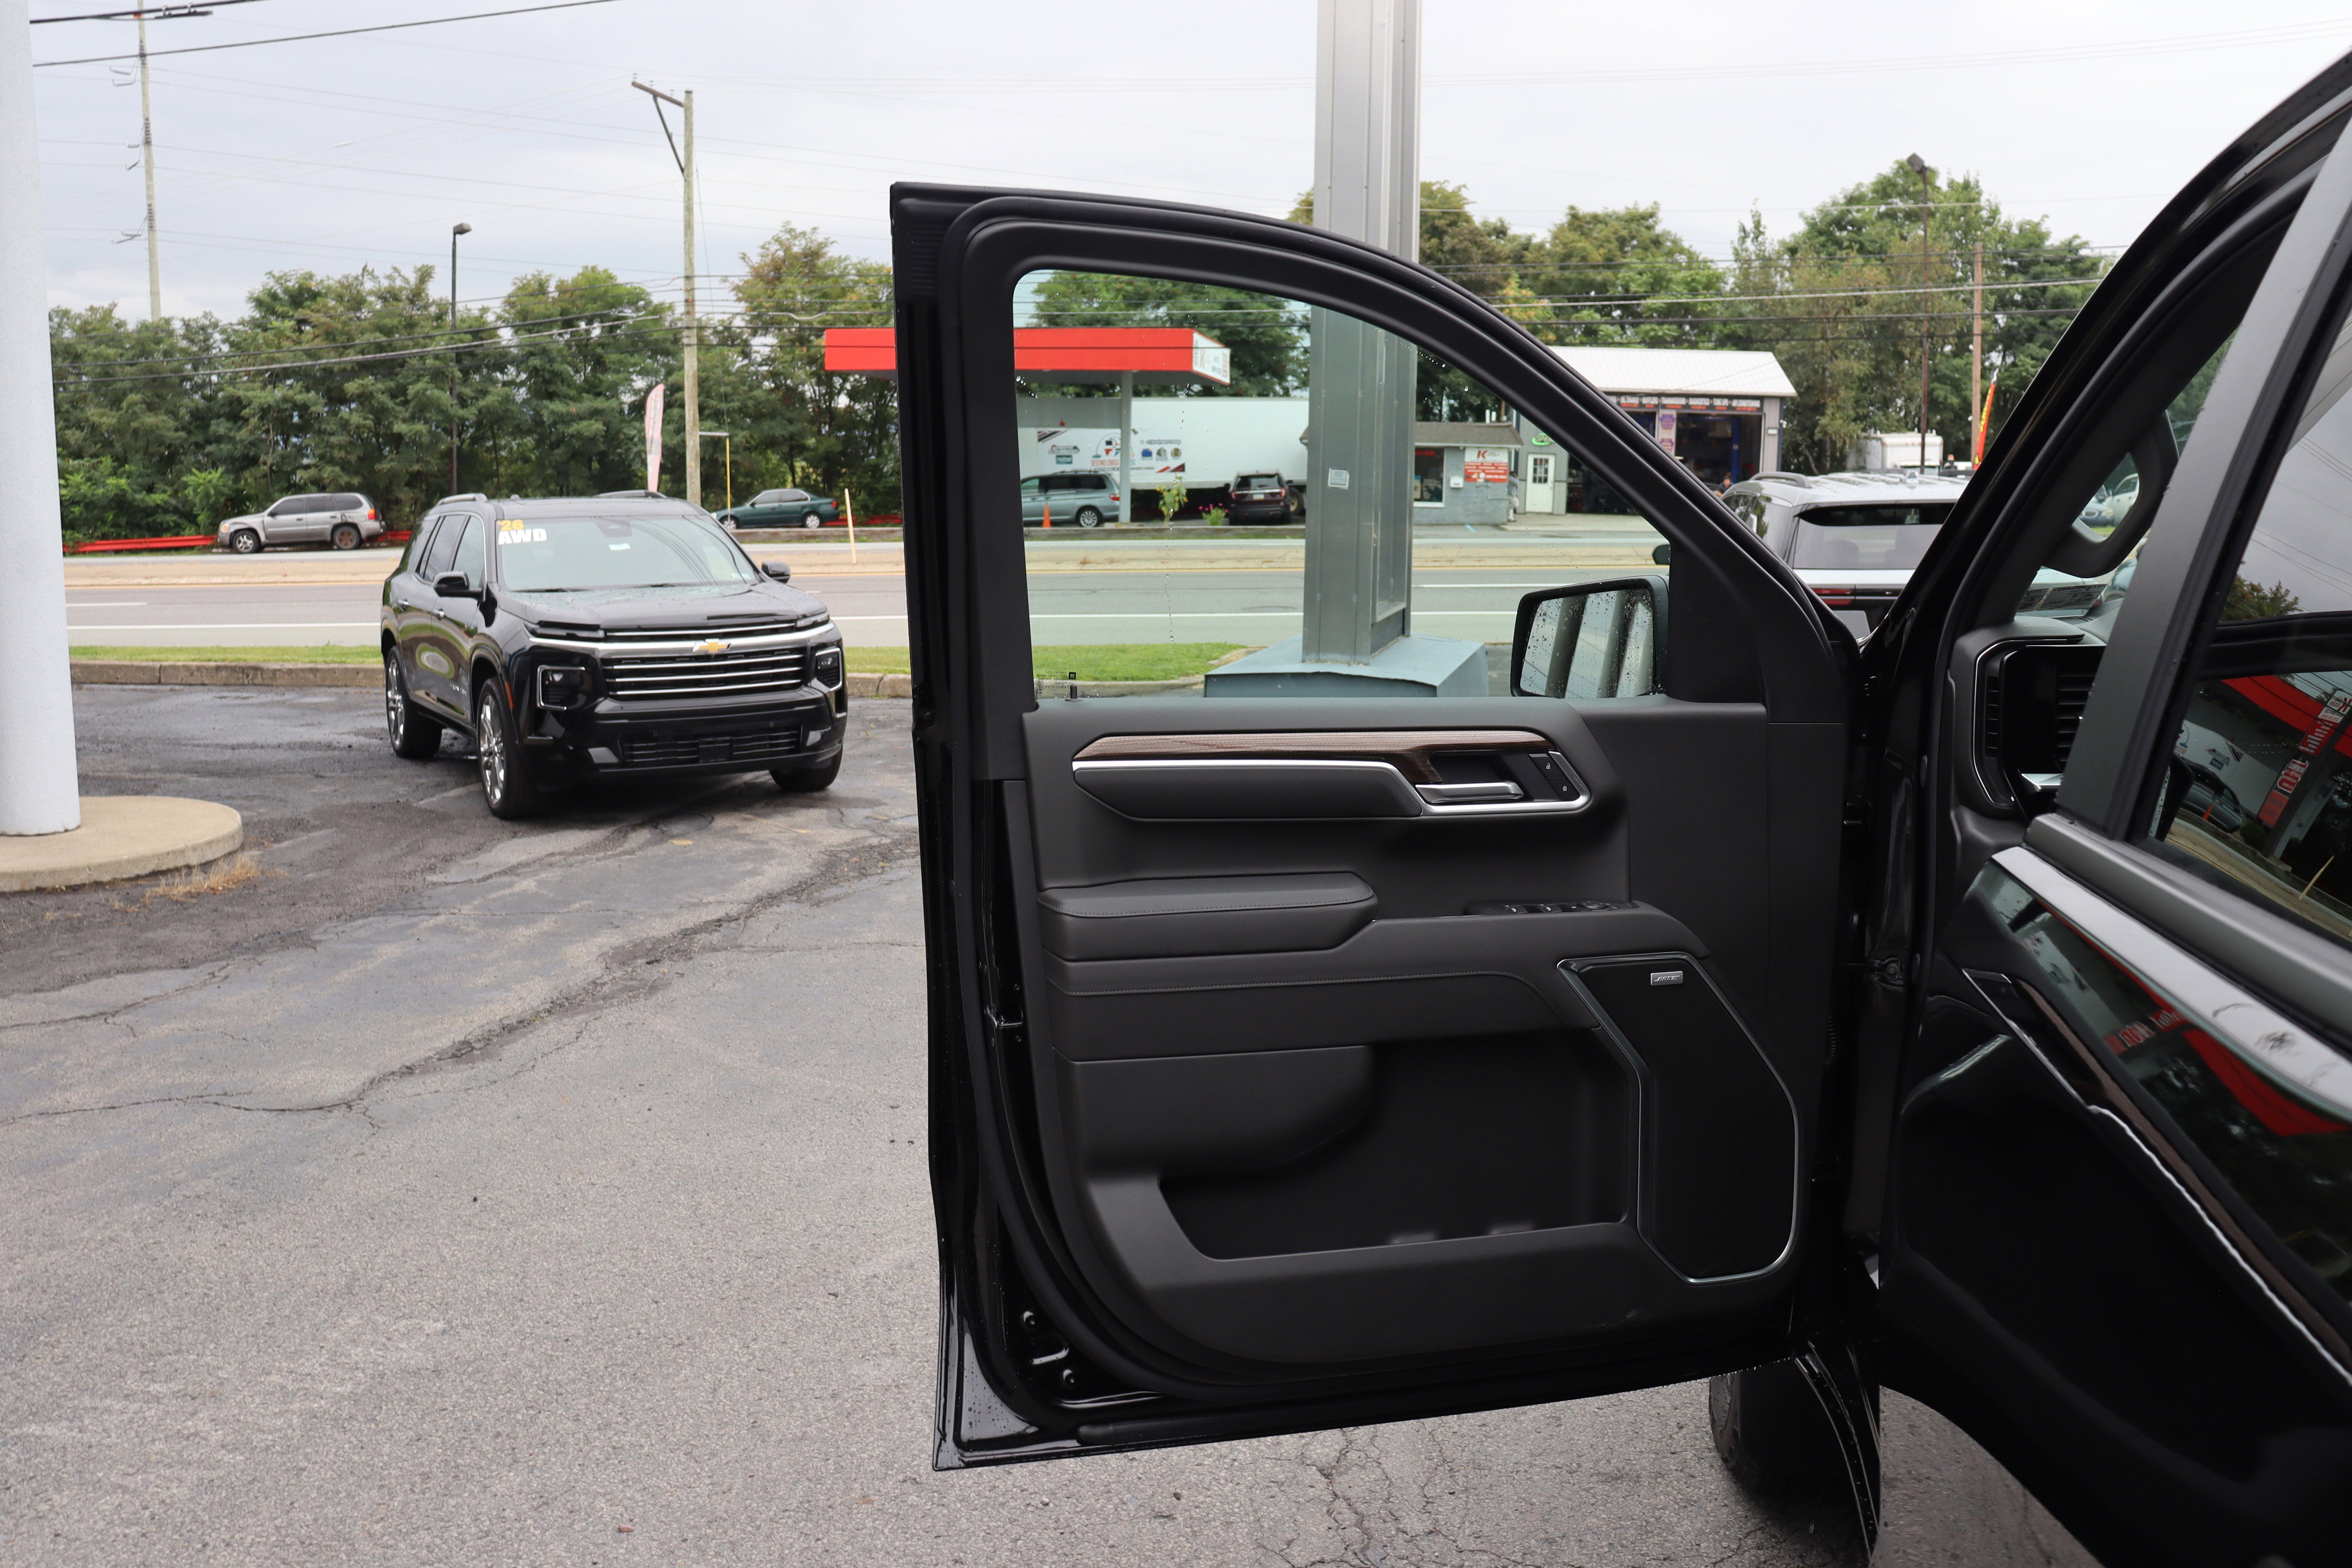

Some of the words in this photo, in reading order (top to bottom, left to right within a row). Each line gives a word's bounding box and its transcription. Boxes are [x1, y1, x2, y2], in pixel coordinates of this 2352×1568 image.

[1477, 450, 1488, 459] K
[497, 519, 524, 531] '26
[498, 528, 547, 545] AWD
